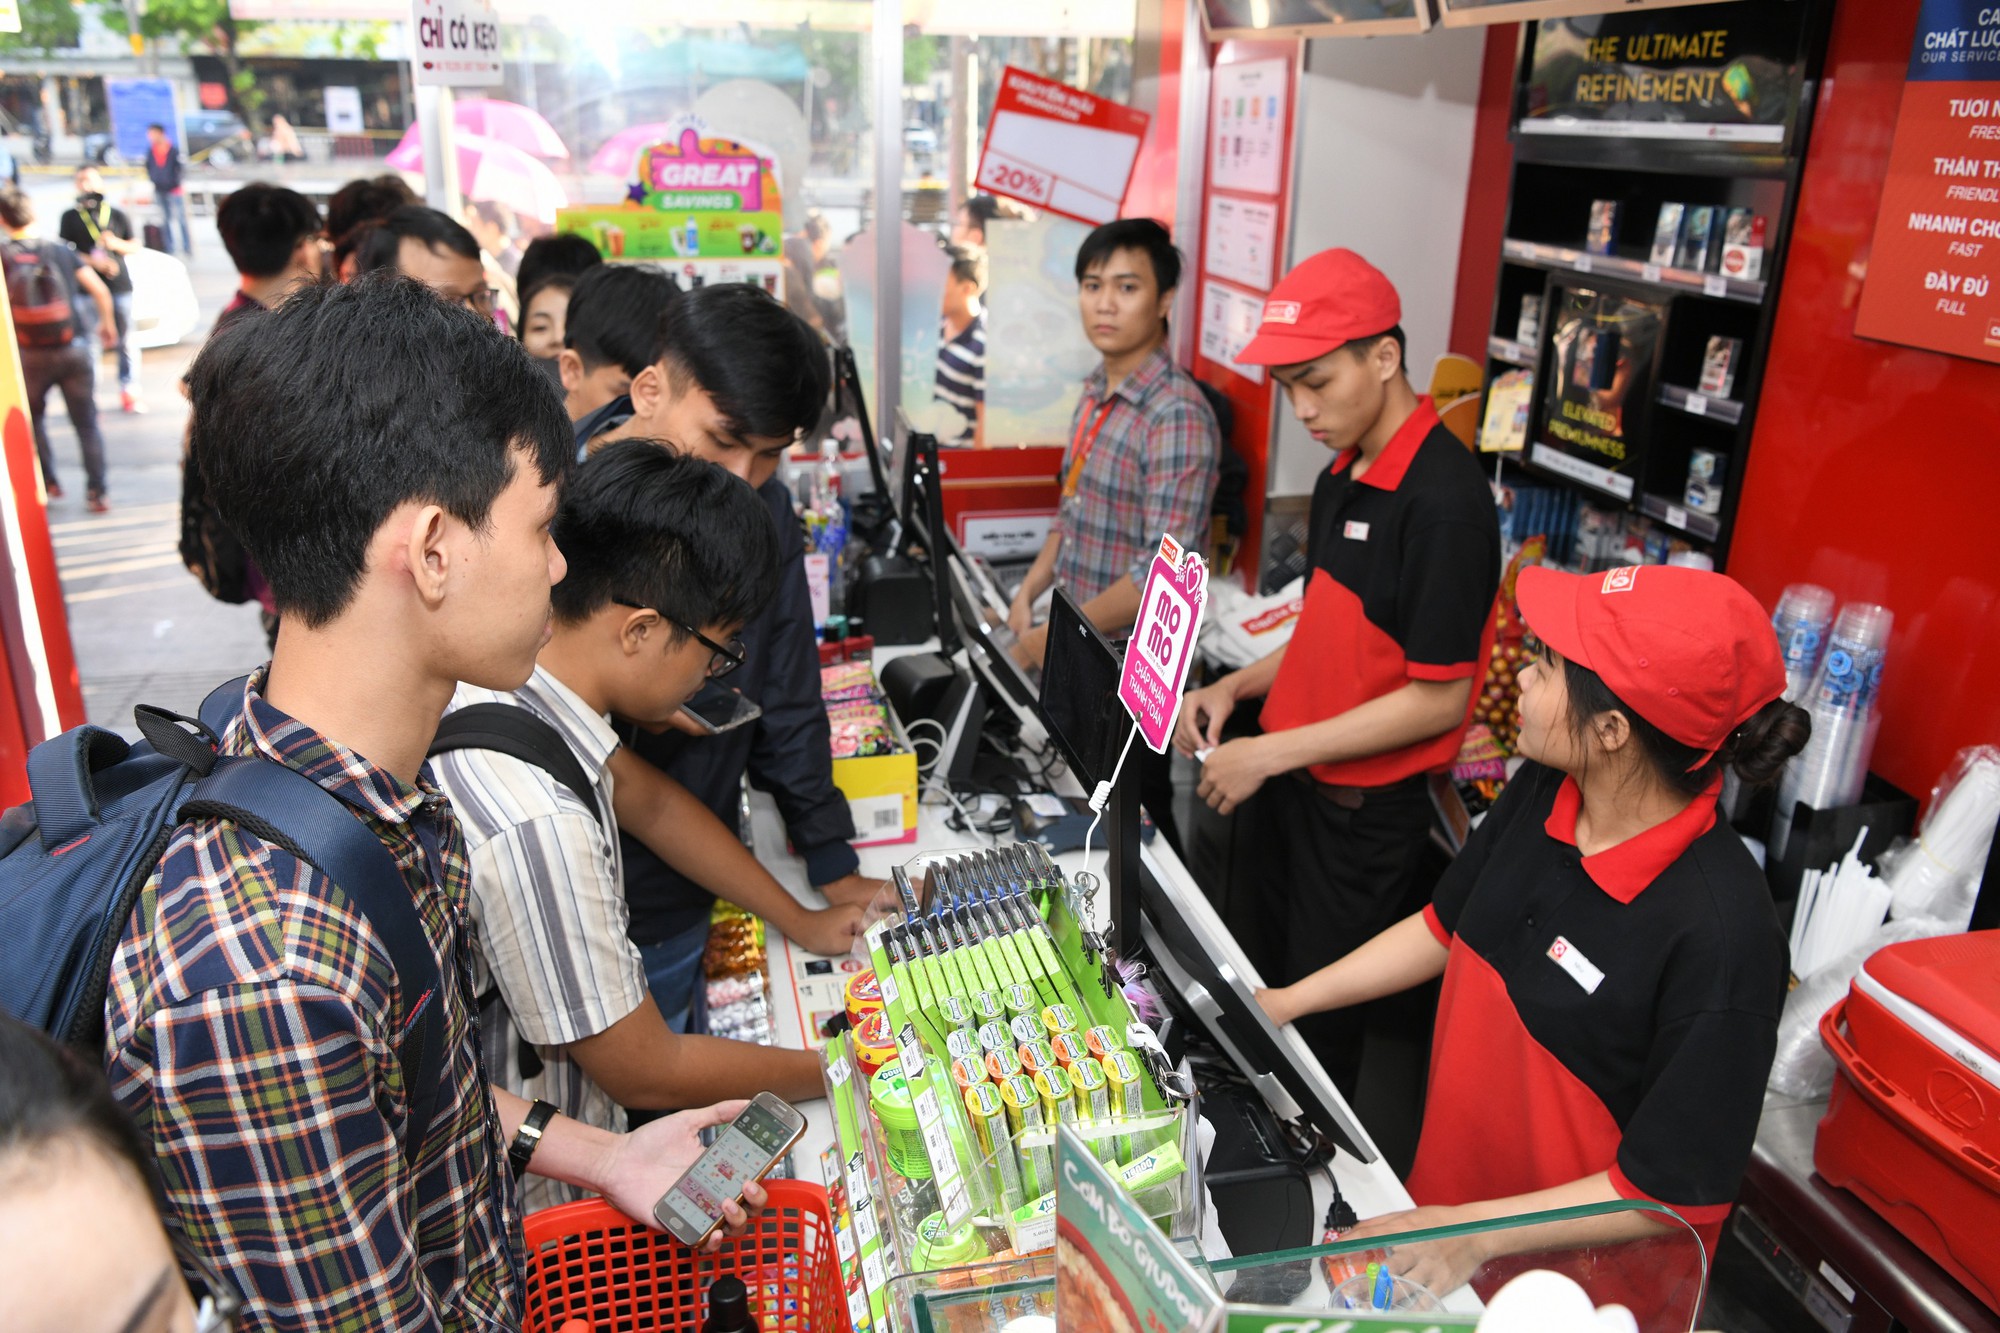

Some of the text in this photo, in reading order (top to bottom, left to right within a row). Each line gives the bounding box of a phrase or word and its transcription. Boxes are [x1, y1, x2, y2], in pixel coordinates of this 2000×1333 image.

[1583, 30, 1728, 63] THE ULTIMATE
[1924, 27, 1968, 49] CHẤT
[1921, 51, 1947, 63] OUR
[1576, 71, 1720, 103] REFINEMENT
[661, 163, 757, 187] GREAT
[987, 165, 1044, 197] -20%
[662, 194, 734, 210] SAVINGS
[1908, 212, 1966, 235] NHANH
[1948, 241, 1983, 258] FAST
[1935, 298, 1967, 316] FULL
[1129, 674, 1164, 728] THANH TOÁN
